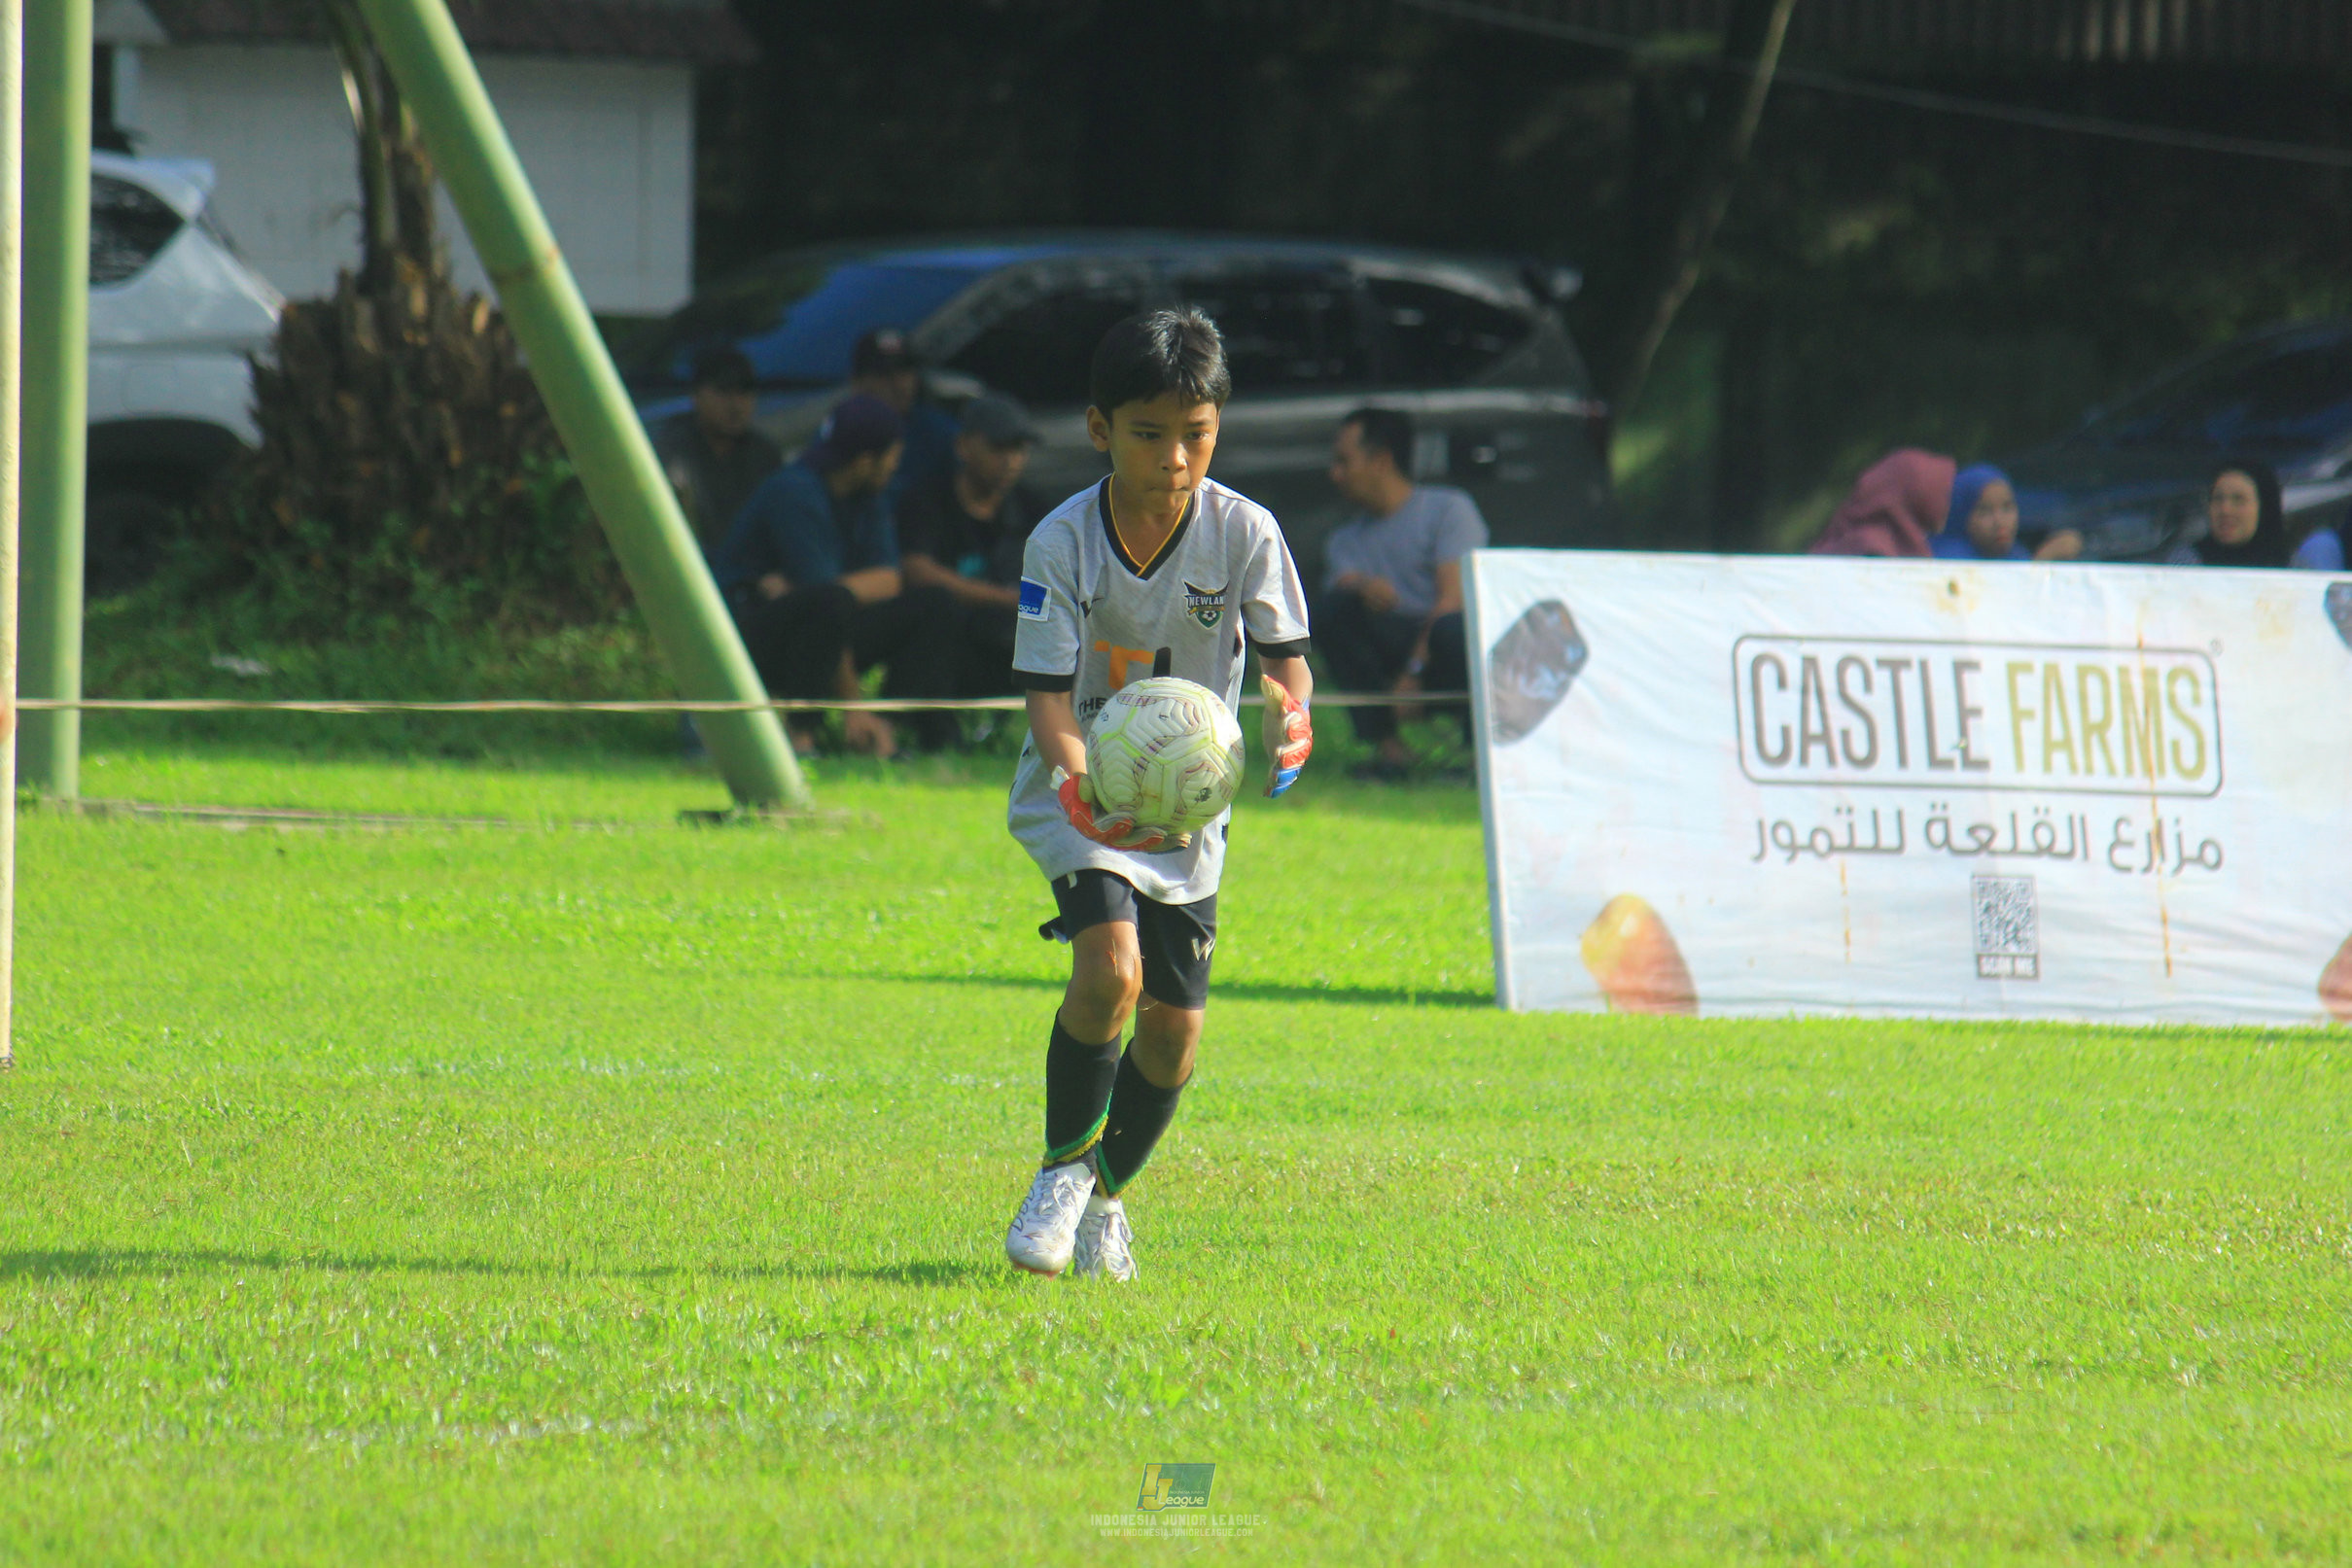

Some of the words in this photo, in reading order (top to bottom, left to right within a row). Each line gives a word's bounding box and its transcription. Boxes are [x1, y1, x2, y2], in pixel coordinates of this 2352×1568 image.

[1751, 652, 1990, 771] CASTLE
[2005, 660, 2208, 780] FARMS
[1752, 806, 1906, 864] للتمور
[1924, 802, 2090, 862] القلعة
[2108, 815, 2224, 875] مزارع
